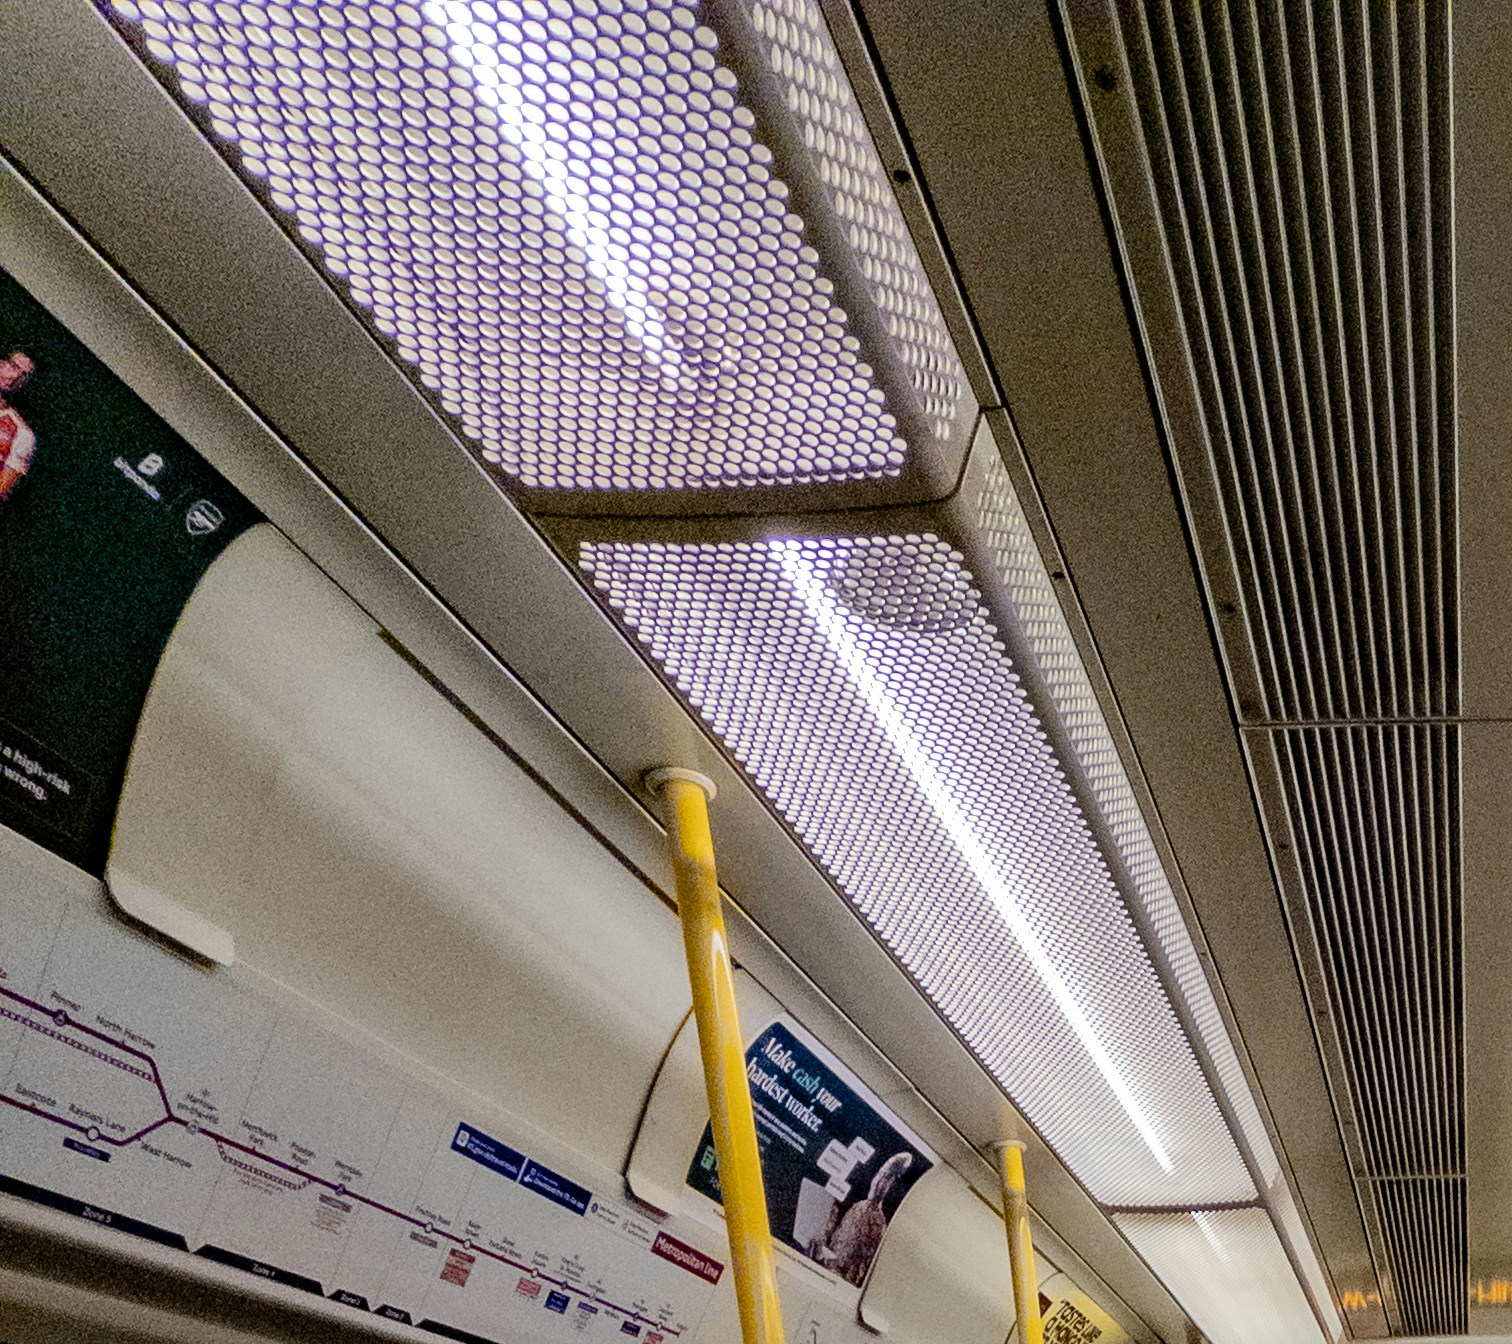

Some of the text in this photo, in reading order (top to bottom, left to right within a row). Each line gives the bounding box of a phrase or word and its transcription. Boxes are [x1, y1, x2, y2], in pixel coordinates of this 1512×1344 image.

[13, 749, 71, 796] high-risk
[747, 1056, 789, 1104] hardest
[785, 1093, 824, 1132] worker.
[761, 1037, 842, 1113] Make cash your
[654, 1236, 703, 1273] Metropolitan
